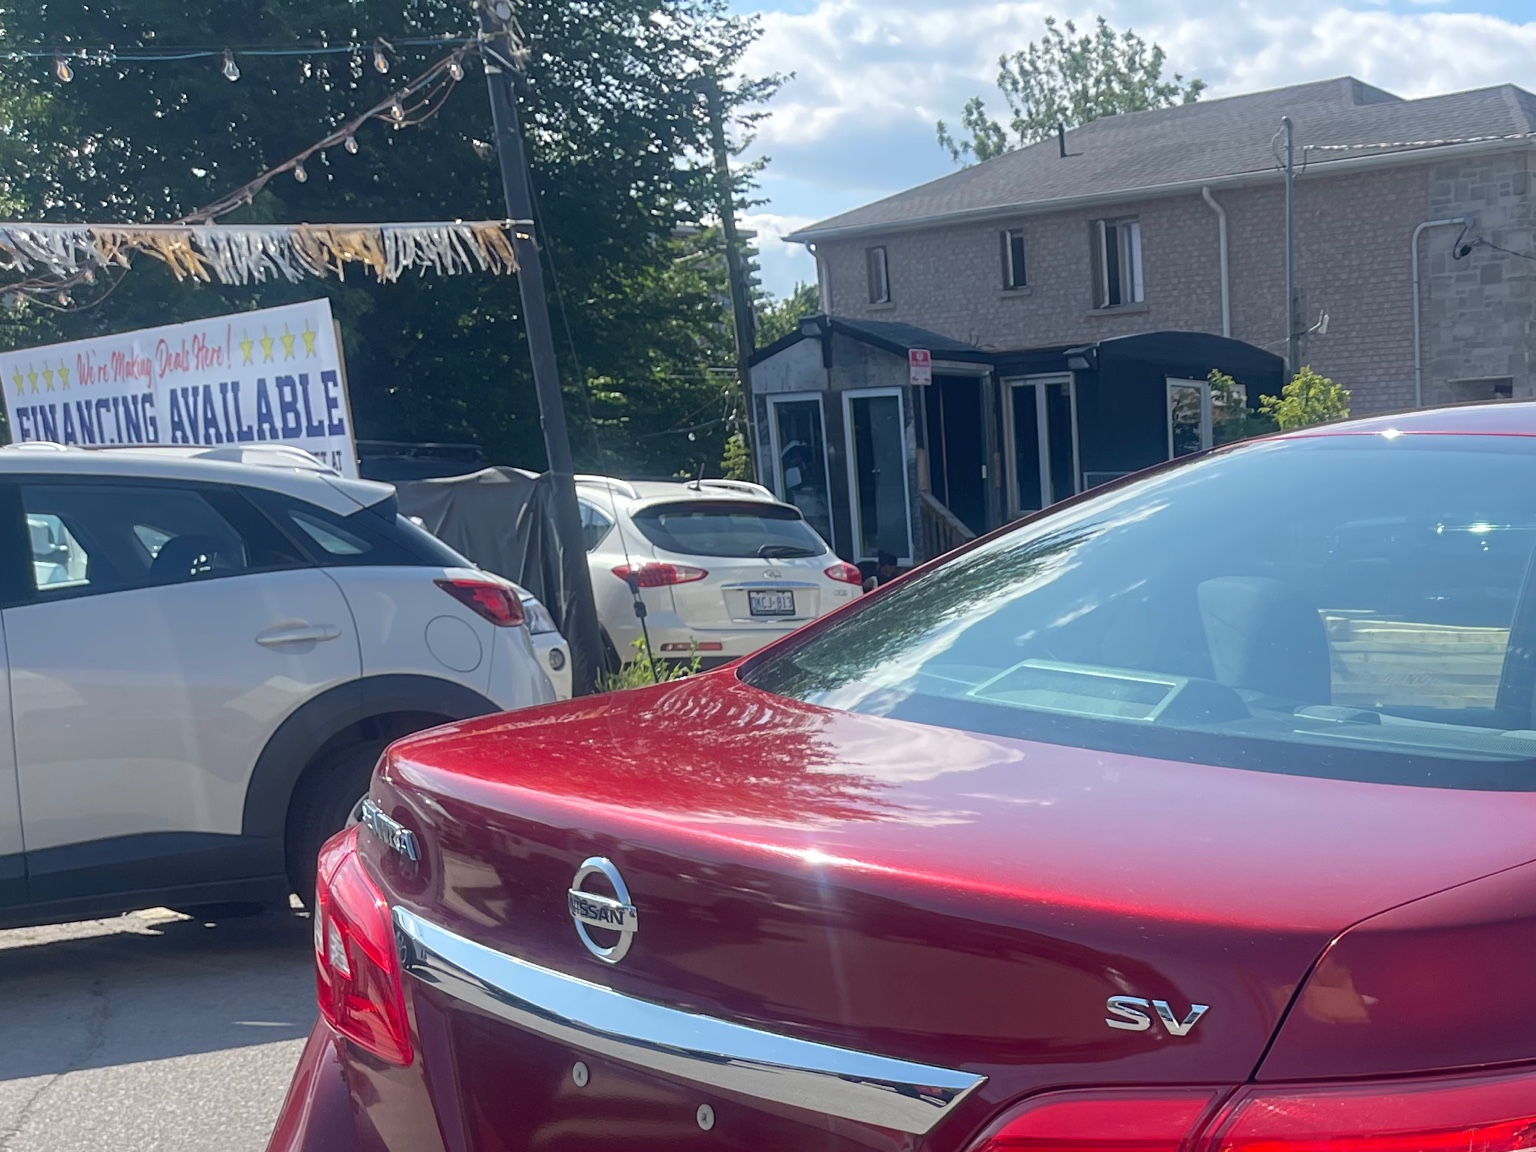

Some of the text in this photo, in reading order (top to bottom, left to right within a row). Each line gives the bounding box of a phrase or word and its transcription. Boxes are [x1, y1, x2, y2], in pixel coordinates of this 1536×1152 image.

[111, 347, 152, 388] Making
[156, 338, 190, 378] Deals
[16, 370, 346, 445] FINANCING AVAILABLE
[1105, 995, 1210, 1036] SV
